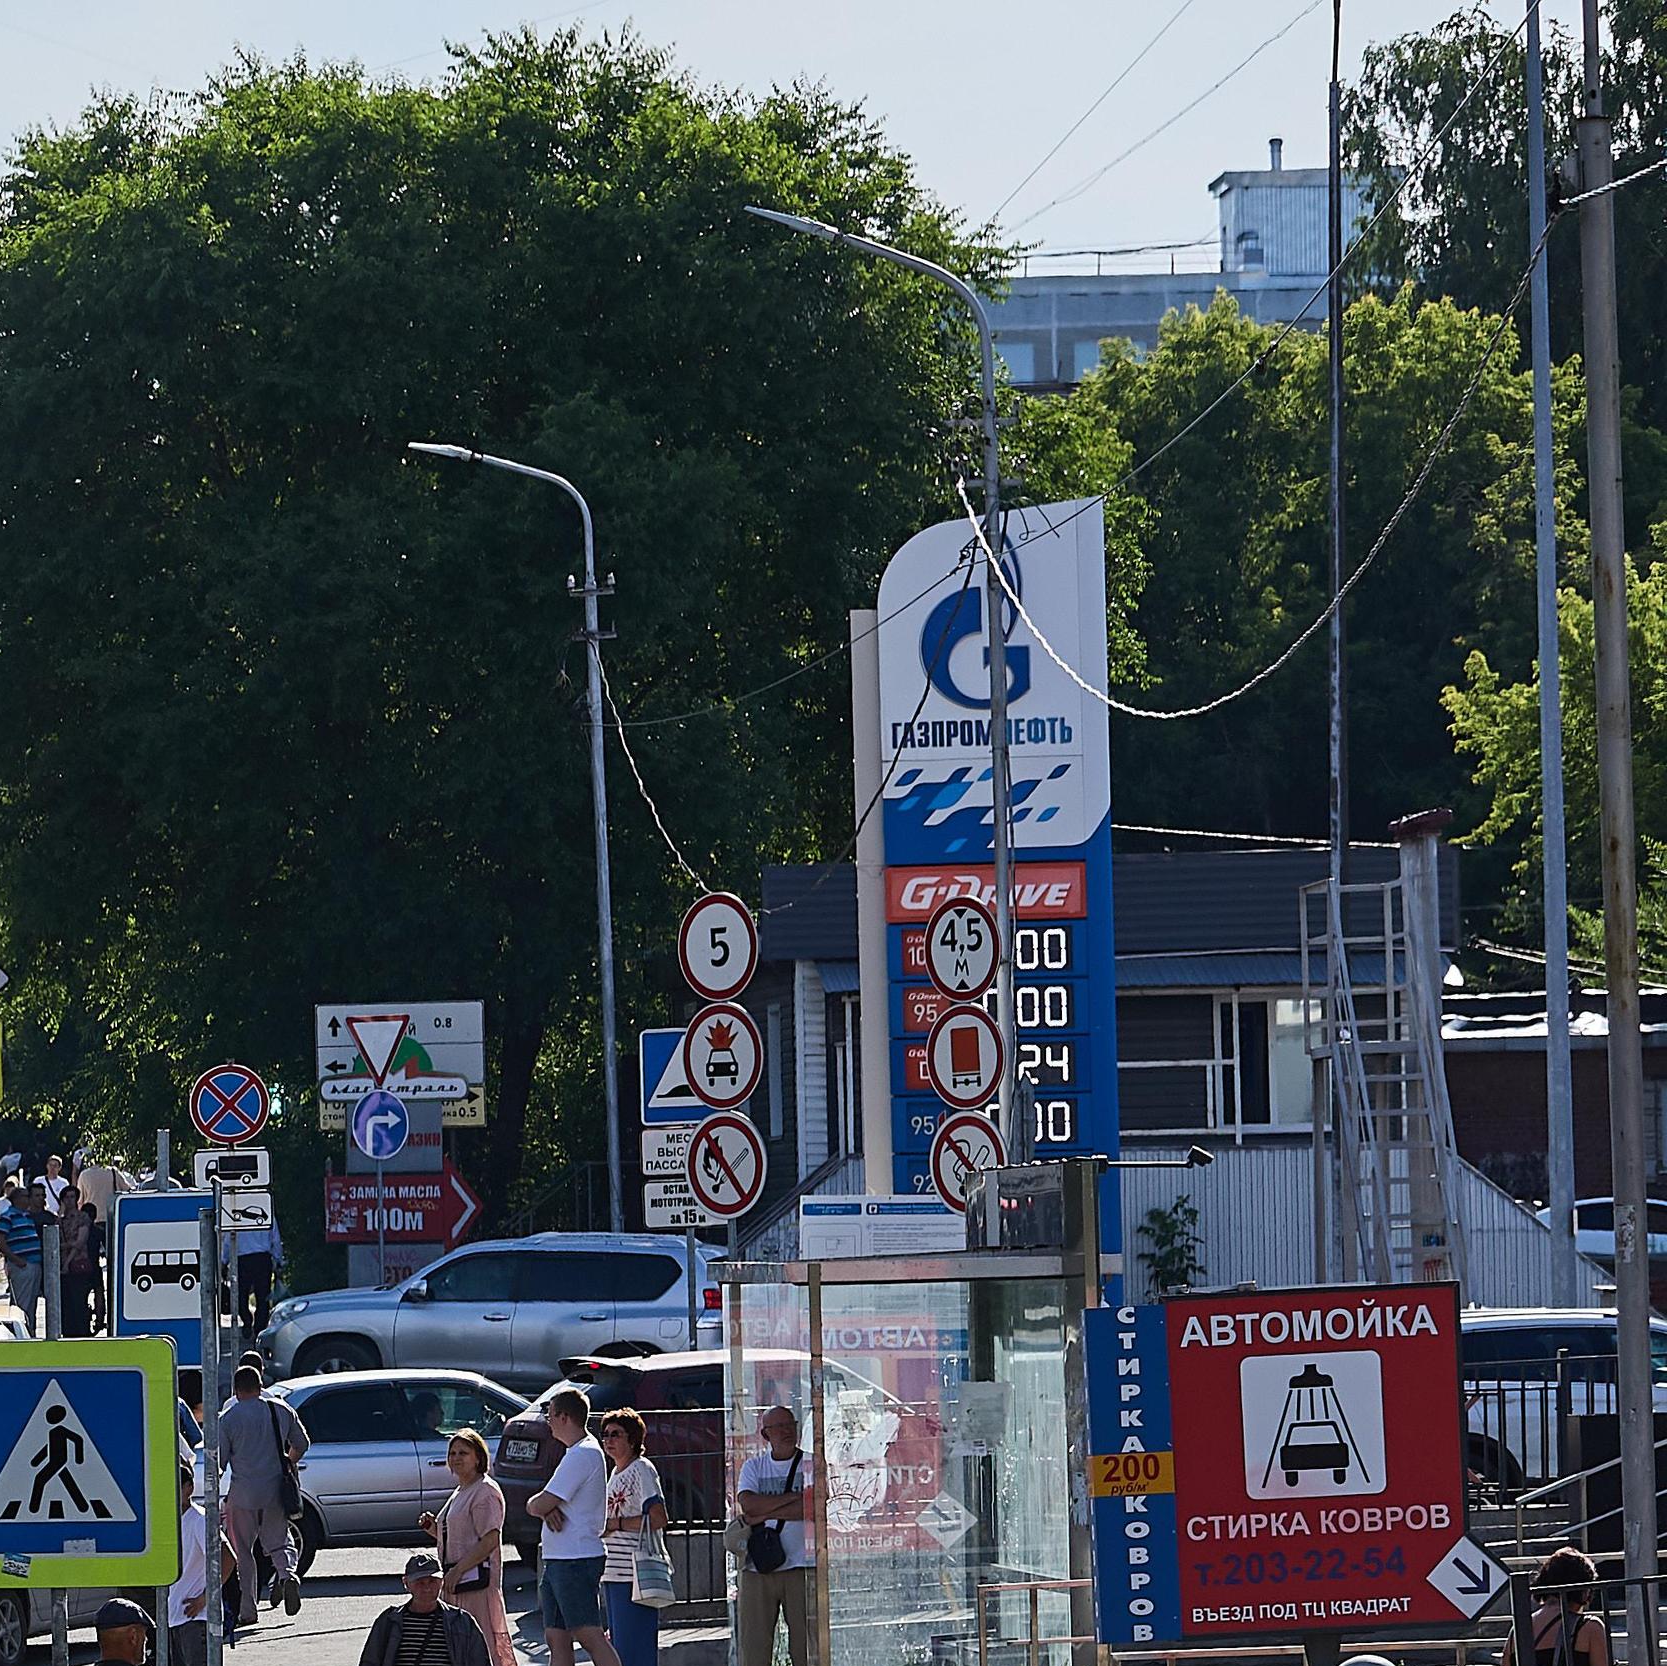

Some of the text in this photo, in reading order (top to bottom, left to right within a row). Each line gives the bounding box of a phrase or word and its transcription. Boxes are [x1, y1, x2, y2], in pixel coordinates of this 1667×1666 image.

[710, 926, 730, 967] 5
[940, 918, 983, 956] 4,5
[434, 1018, 452, 1028] 0.8
[914, 1004, 938, 1023] 95
[331, 1084, 458, 1097] Магстраль
[458, 1107, 477, 1117] 0.5
[911, 1116, 934, 1135] 95
[349, 1185, 441, 1199] ЗАМНА МАСЛА
[913, 1175, 937, 1193] 92
[682, 1209, 697, 1223] 15
[1180, 1299, 1438, 1348] АВТОМОЙКА
[1116, 1306, 1146, 1453] СТИРКА
[1103, 1454, 1160, 1483] 200
[1187, 1504, 1451, 1540] СТИРКА КОВРОВ
[1124, 1495, 1154, 1642] КОВРОВ
[1194, 1546, 1407, 1587] т.203-22-54
[1192, 1597, 1411, 1623] ВЪЕЗД ПОД ТЦ КВАДРАТ
